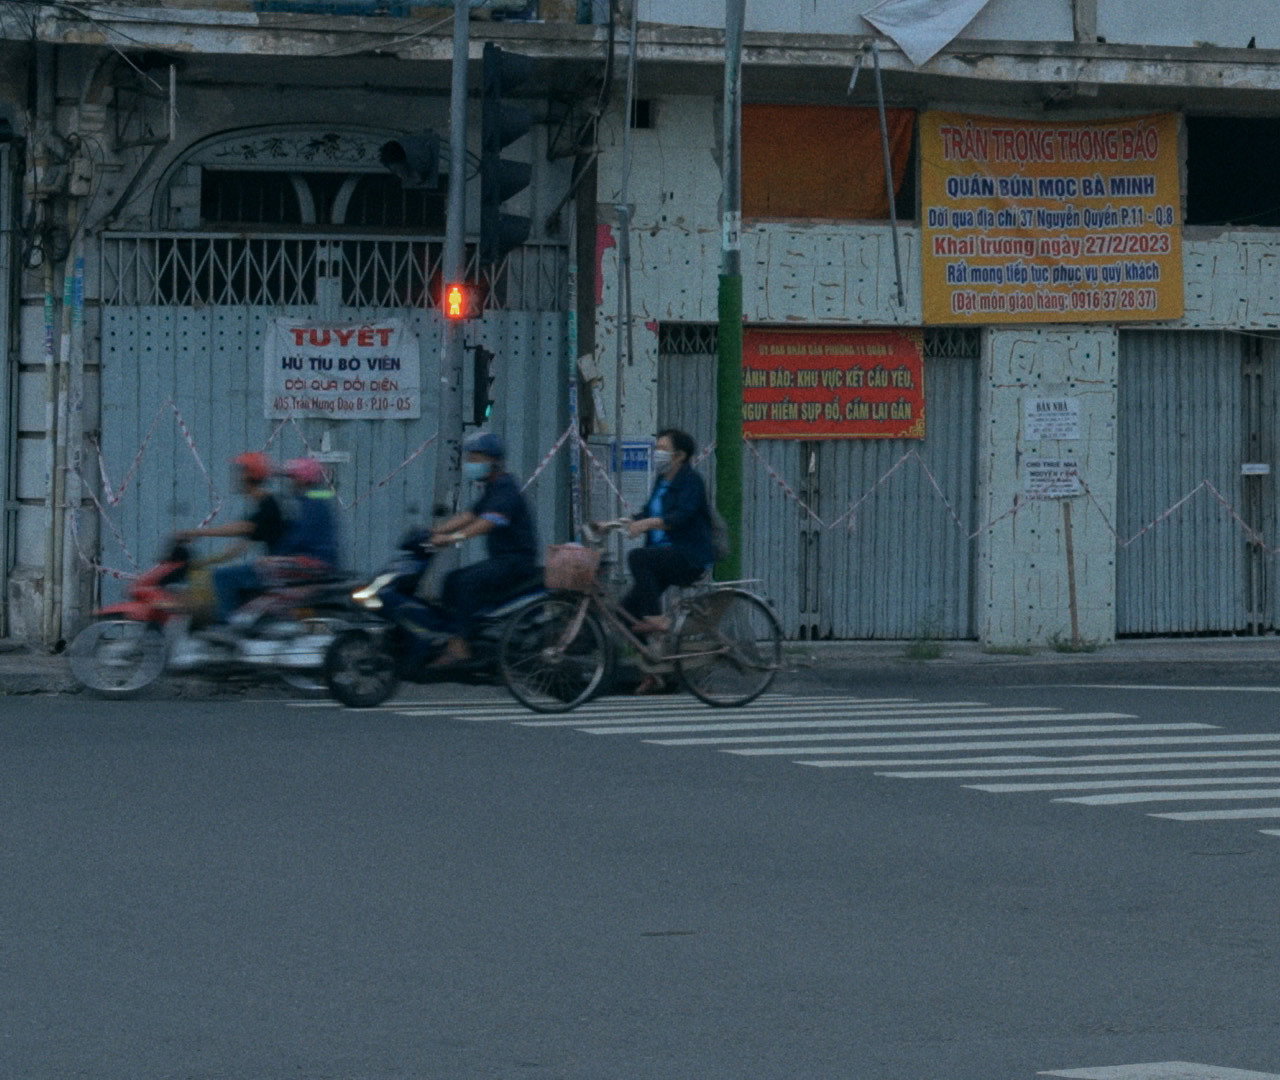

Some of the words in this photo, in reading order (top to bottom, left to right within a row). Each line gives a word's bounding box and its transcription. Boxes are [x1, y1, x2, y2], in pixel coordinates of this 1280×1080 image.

[941, 121, 988, 159] TRÂN
[992, 129, 1054, 167] TRỌNG
[1058, 126, 1118, 160] THÔNG
[1121, 122, 1158, 159] BÁO
[947, 174, 994, 197] QUÁN
[999, 175, 1033, 196] BÚN
[1039, 178, 1077, 200] MỌC
[1082, 174, 1105, 196] BÀ
[1110, 177, 1155, 195] MINH
[952, 211, 973, 229] qua
[1021, 209, 1033, 227] 37
[1155, 207, 1173, 225] Q.8
[935, 236, 974, 254] Khai
[1040, 236, 1080, 256] ngày
[1086, 235, 1169, 254] 27/2/2023
[971, 266, 1003, 284] mong
[1009, 293, 1033, 311] giao
[1071, 291, 1100, 309] 0916
[1103, 291, 1117, 308] 37
[1121, 290, 1135, 308] 28
[290, 323, 394, 347] TUYẾT
[311, 379, 337, 391] QUA
[743, 365, 767, 388] ẢNH
[769, 366, 794, 388] BÁO:
[797, 369, 819, 388] KHU
[821, 367, 843, 391] VỰC
[846, 365, 865, 388] KẾT
[867, 365, 889, 388] CẤU
[891, 365, 915, 390] YẾU,
[771, 395, 799, 420] HIỂM
[801, 402, 822, 423] SỤP
[846, 396, 869, 420] CẤM
[872, 402, 889, 423] LẠI
